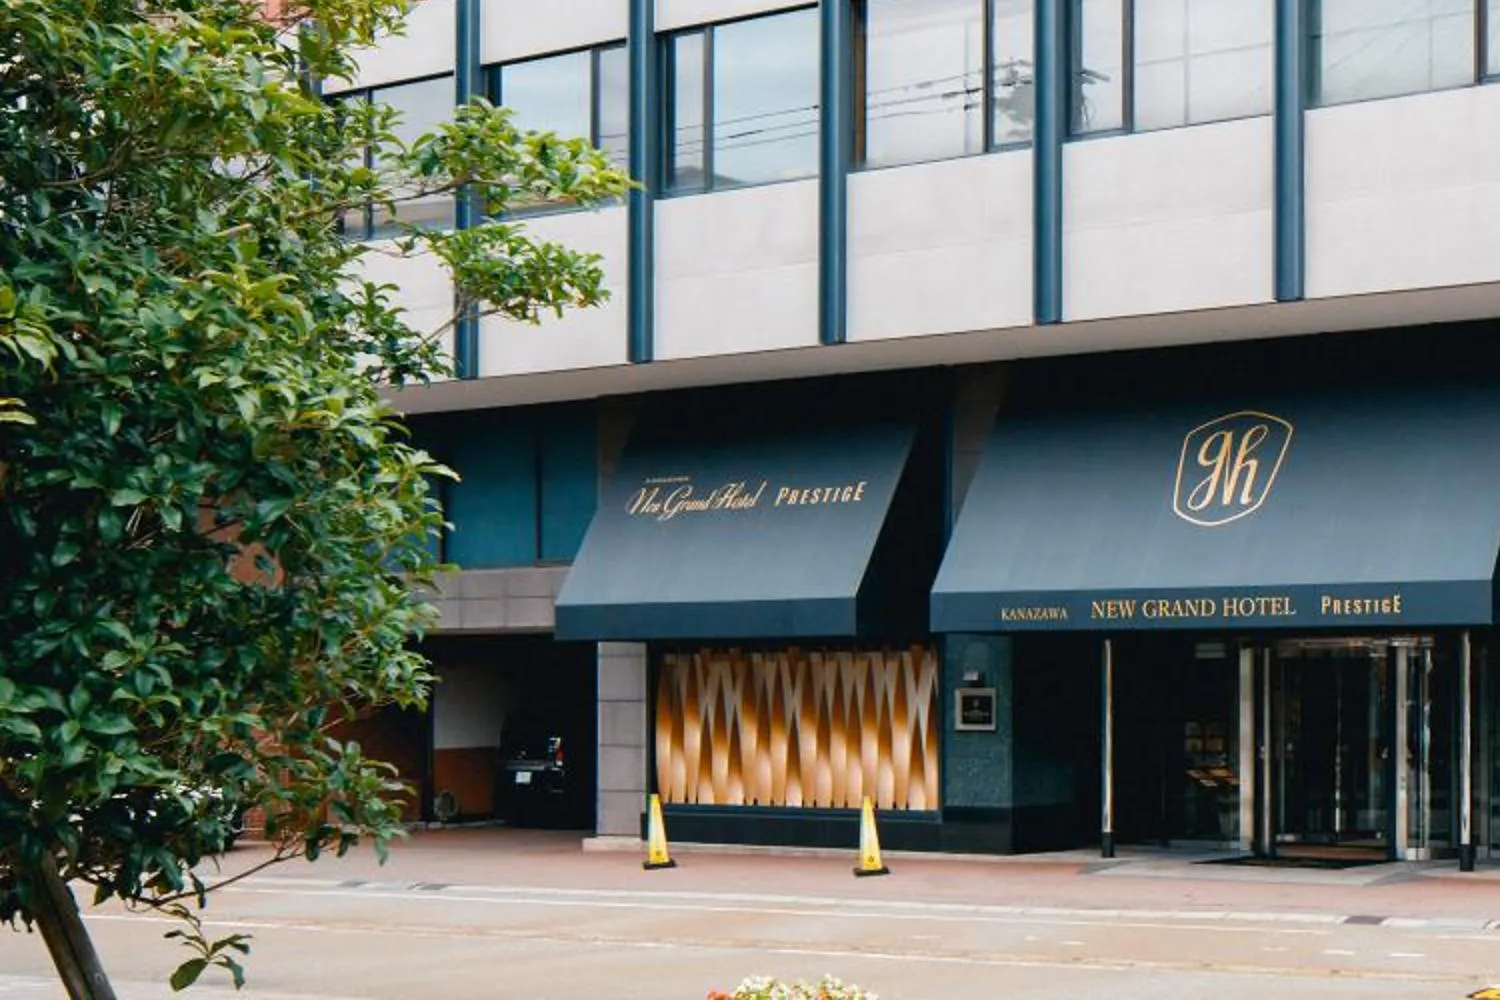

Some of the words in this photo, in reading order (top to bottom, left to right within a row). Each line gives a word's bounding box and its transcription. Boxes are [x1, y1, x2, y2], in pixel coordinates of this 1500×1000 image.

[657, 483, 717, 522] Grand
[713, 479, 768, 513] Hotel
[773, 480, 868, 507] PRESTIGE
[1000, 605, 1069, 622] KANAZAWA
[1089, 599, 1137, 620] NEW
[1141, 598, 1217, 619] GRAND
[1221, 595, 1297, 618] HOTEL
[1320, 593, 1402, 615] PRESTIGE
